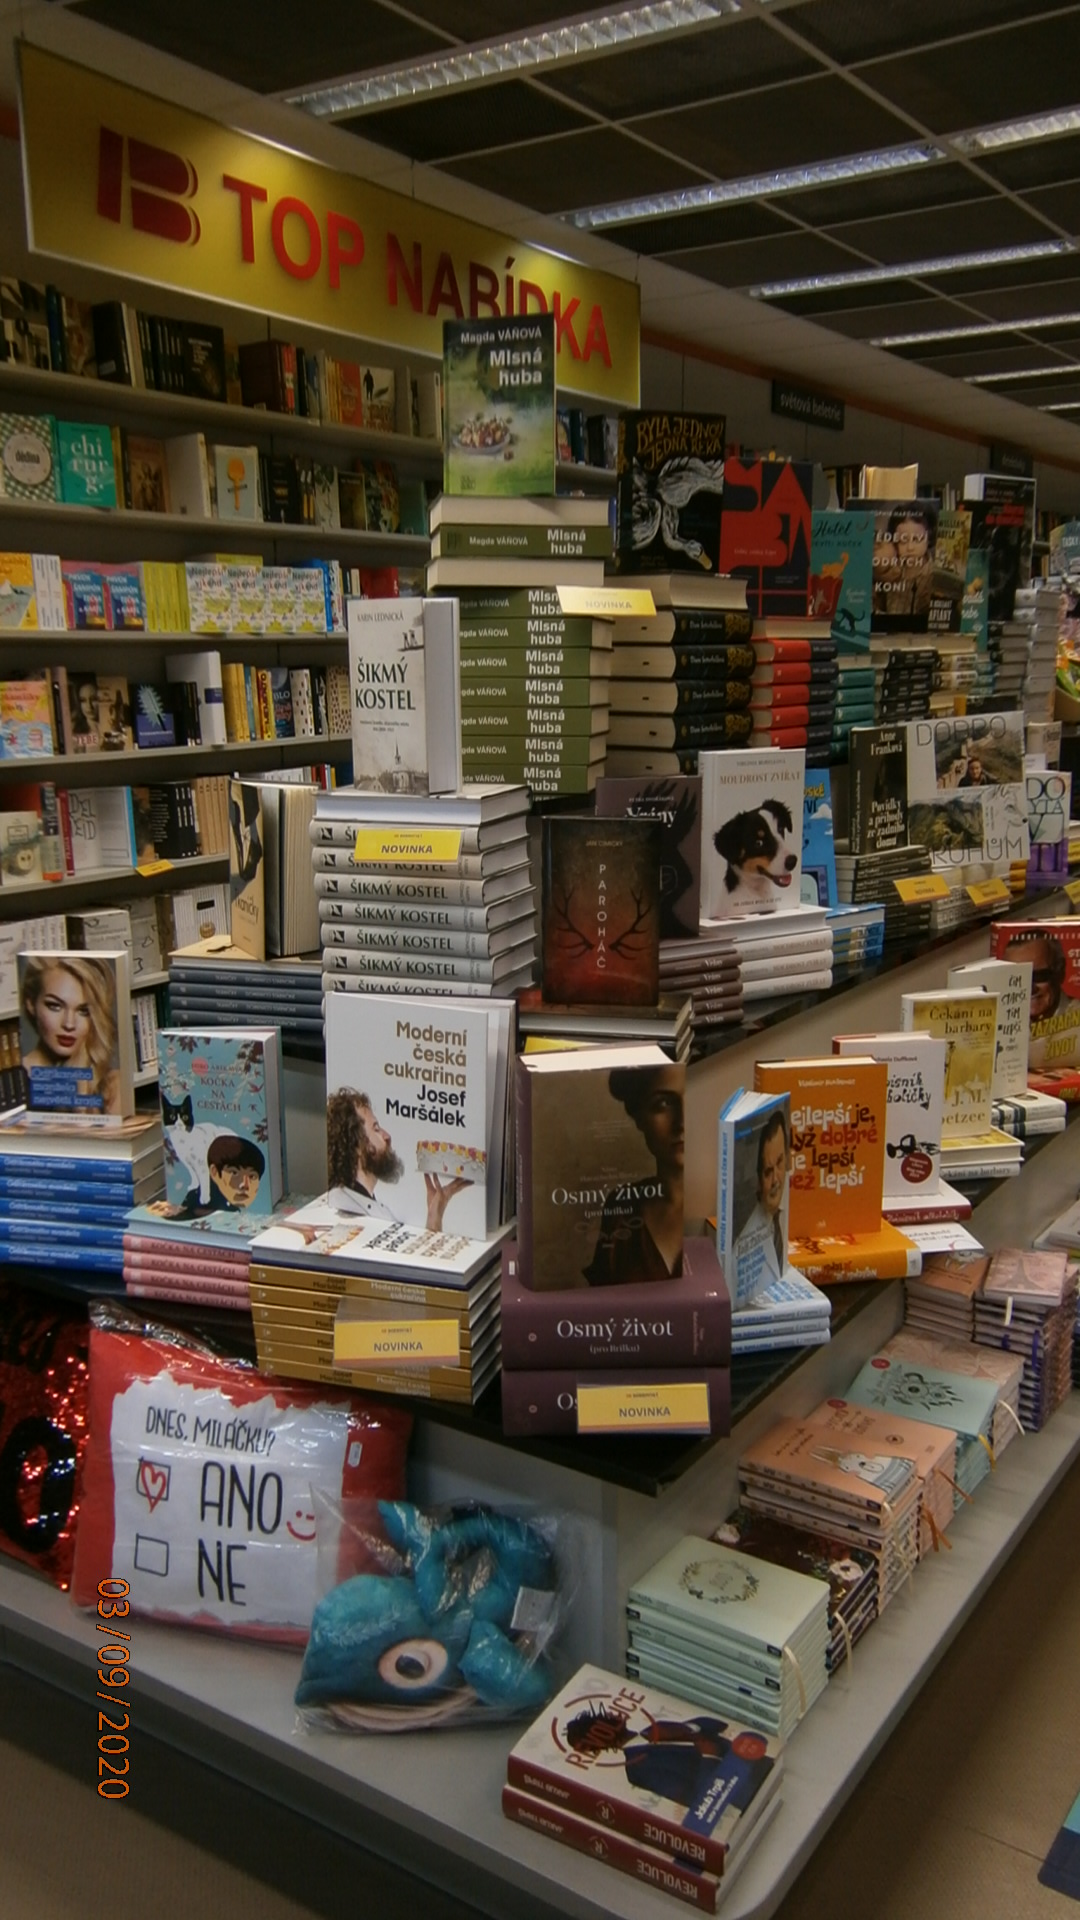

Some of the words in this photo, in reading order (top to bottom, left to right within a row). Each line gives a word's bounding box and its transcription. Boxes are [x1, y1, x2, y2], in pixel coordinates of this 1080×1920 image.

[222, 172, 366, 290] TOP
[385, 232, 613, 369] NABÍDKA
[461, 332, 495, 344] Magda
[498, 326, 542, 341] VÁŇOVÁ
[490, 348, 542, 367] Mlsná
[499, 369, 542, 387] huba
[780, 393, 811, 413] světová
[637, 416, 670, 452] BYLA
[673, 417, 723, 439] JEDNOU
[71, 434, 102, 457] chi
[646, 436, 688, 469] JEDNA
[547, 528, 586, 544] Mlsná
[814, 519, 852, 537] Hotel
[469, 536, 495, 547] Magda
[496, 535, 529, 546] VÁŇOVÁ
[550, 542, 583, 555] huba
[872, 555, 924, 567] ODRÝCH
[528, 590, 559, 602] Mlsn
[874, 581, 907, 593] KONÍ
[527, 620, 566, 632] Mlsná
[531, 633, 562, 645] huba
[526, 650, 564, 662] Mlsná
[357, 656, 408, 683] ŠIKMÝ
[529, 663, 560, 675] huba
[525, 679, 563, 692] Mlsná
[355, 689, 416, 711] KOSTEL
[529, 694, 560, 705] huba
[527, 709, 565, 721] Mlsná
[530, 722, 561, 734] huba
[879, 731, 897, 741] Anne
[525, 738, 563, 750] Mlsná
[870, 740, 903, 756] Franková
[529, 752, 560, 763] huba
[524, 767, 561, 779] Mlsná
[720, 772, 767, 785] MOUDROST
[527, 780, 558, 792] huba
[871, 800, 902, 814] Povídky
[381, 844, 434, 854] NOVINKA
[932, 836, 1023, 865] RUHŮM
[350, 878, 392, 895] ŠIKMÝ
[396, 885, 448, 899] KOSTEL
[355, 904, 396, 920] ŠIKMÝ
[400, 910, 452, 925] KOSTEL
[596, 864, 607, 969] PAROHÁČ
[357, 929, 398, 945] ŠIKMÝ
[403, 935, 454, 950] KOSTEL
[359, 955, 401, 972] ŠIKMÝ
[406, 961, 458, 976] KOSTEL
[929, 1005, 975, 1022] Čekání
[978, 1008, 993, 1018] na
[396, 1021, 468, 1047] Moderní
[945, 1021, 993, 1037] barbary
[1030, 1010, 1080, 1041] ZÁZRAČN
[413, 1047, 467, 1067] česká
[200, 1077, 235, 1087] KOČKA
[384, 1062, 467, 1088] cukrařina
[211, 1089, 225, 1099] NA
[417, 1085, 466, 1107] Josef
[952, 1090, 964, 1108] J.
[968, 1089, 986, 1104] M.
[386, 1098, 465, 1127] Maršálek
[790, 1103, 852, 1132] ejlepší
[851, 1104, 876, 1128] je,
[941, 1110, 986, 1126] oetzee
[820, 1123, 878, 1147] dobré
[790, 1151, 807, 1176] je
[812, 1144, 857, 1173] lepší
[819, 1165, 866, 1195] lepší
[942, 1168, 966, 1178] ekání
[551, 1183, 610, 1207] Osmý
[615, 1181, 664, 1201] život
[556, 1317, 617, 1343] Osmý
[622, 1317, 674, 1337] život
[373, 1341, 423, 1353] NOVINKA
[590, 1344, 609, 1354] (pro
[619, 1407, 671, 1418] NOVINKA
[192, 1416, 276, 1456] MILÁČKU?
[200, 1460, 283, 1535] ANO
[197, 1538, 247, 1607] NE
[643, 1823, 706, 1862] REVOLUCE
[636, 1858, 698, 1897] REVOLUCE
